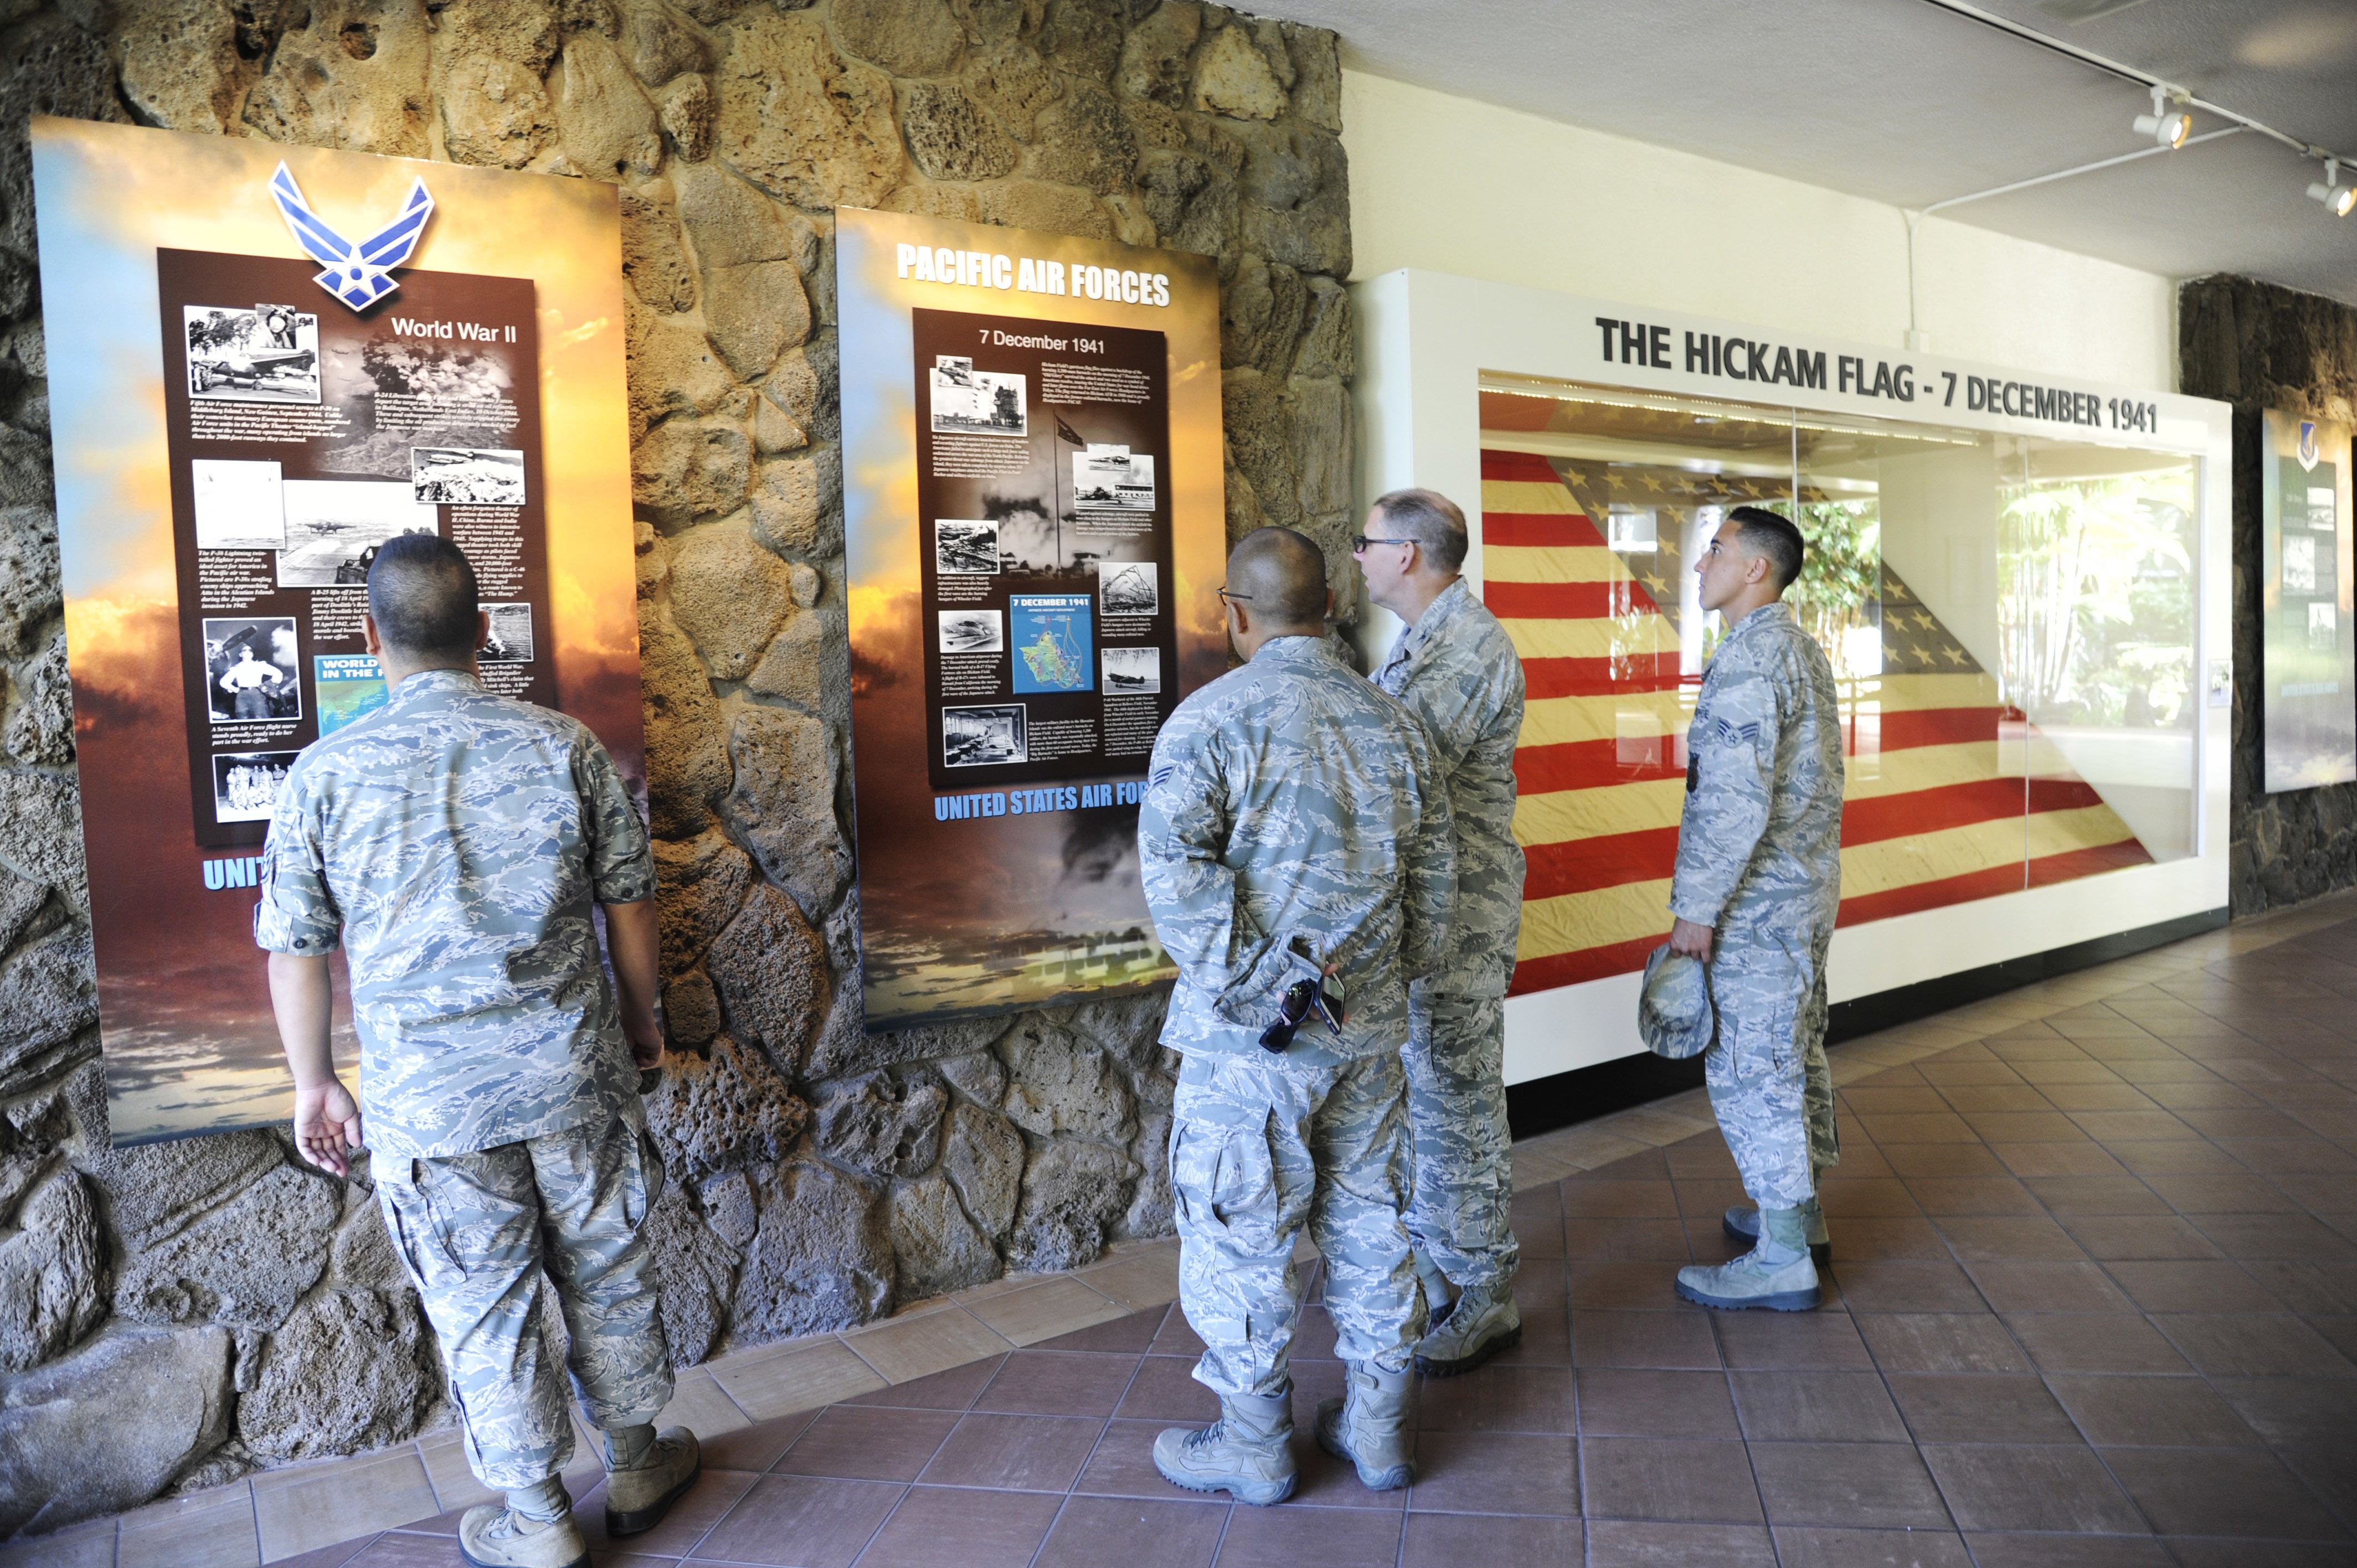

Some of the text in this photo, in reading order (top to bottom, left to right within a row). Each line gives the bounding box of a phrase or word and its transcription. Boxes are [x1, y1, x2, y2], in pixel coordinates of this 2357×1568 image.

[897, 243, 1170, 307] PACIFIC AIR FORCES
[391, 317, 517, 343] World War II
[979, 329, 1105, 354] 7 December 1941
[1595, 316, 2158, 434] THE HICKAM FLAG - 7 DECEMBER 1941
[322, 659, 378, 668] WORLD
[322, 670, 339, 678] IN
[342, 669, 373, 678] THE
[934, 781, 1148, 821] UNITED STATES AIR FOR
